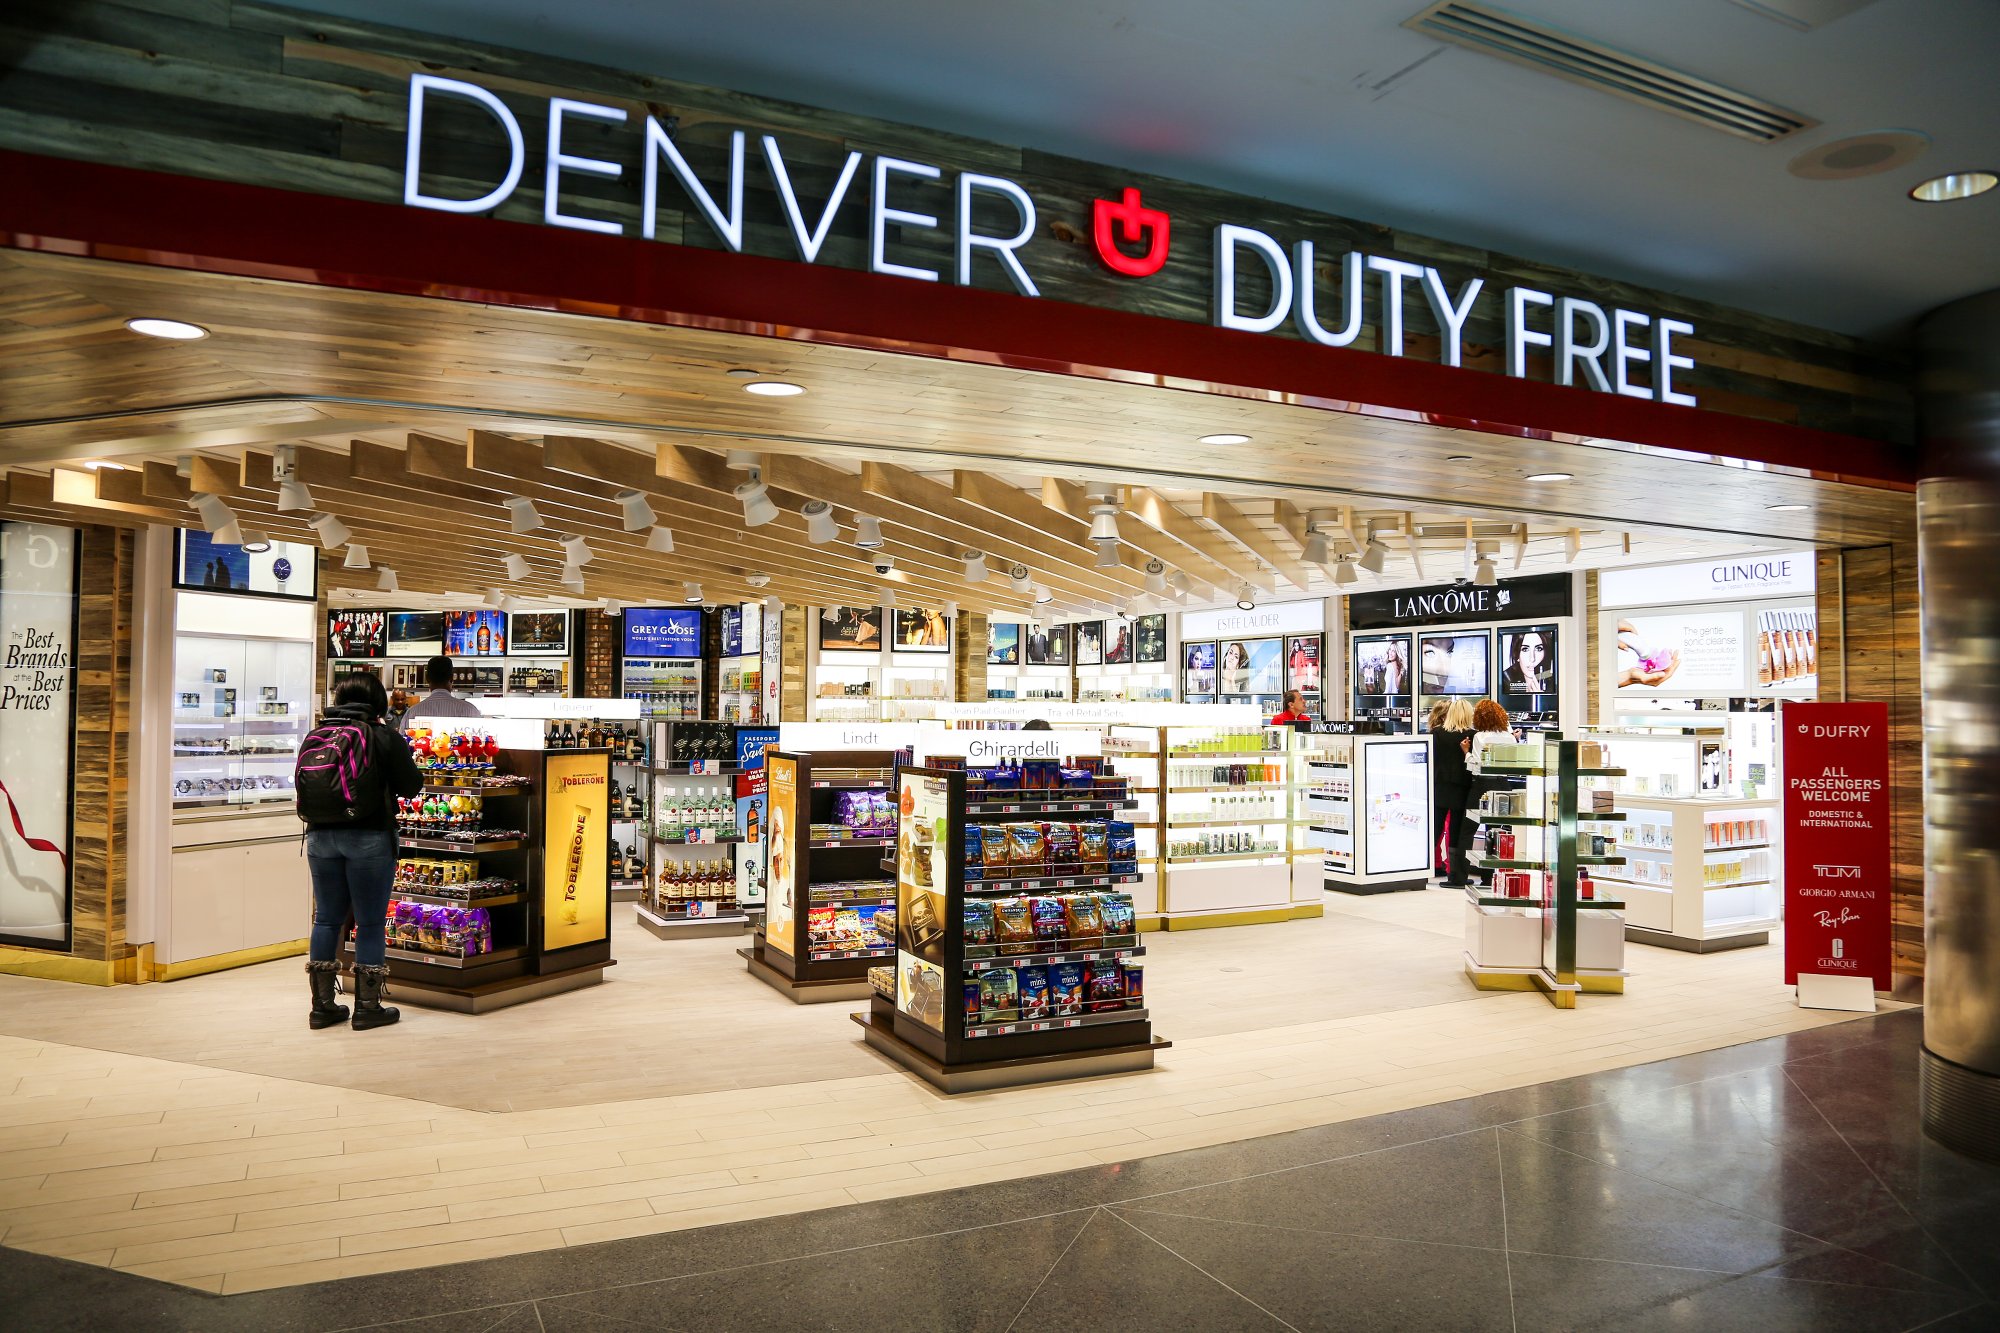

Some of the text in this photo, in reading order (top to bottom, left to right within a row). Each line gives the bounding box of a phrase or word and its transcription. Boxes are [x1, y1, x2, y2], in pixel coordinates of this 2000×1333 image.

[404, 73, 1040, 297] DENVER
[1214, 223, 1697, 407] DUTY FREE
[1711, 560, 1792, 583] CLINIQUE
[1394, 588, 1489, 618] LANCÔME
[1243, 613, 1279, 629] LAUDER
[631, 625, 695, 635] GREY GOOSE
[1699, 626, 1724, 638] gentle
[12, 627, 55, 649] The Best
[1683, 638, 1704, 647] sonic
[4, 643, 68, 669] Brands
[13, 670, 65, 692] at the Best
[0, 684, 52, 711] Prices
[553, 701, 593, 712] Liqueur
[950, 706, 1026, 716] Jean Paul Gaultier
[1047, 708, 1124, 718] Trael Retail Sets
[1310, 722, 1347, 733] LANCÔME
[1814, 725, 1871, 738] DUFRY
[843, 731, 879, 745] Lindt
[969, 740, 1059, 757] Ghirardelli
[748, 773, 764, 781] BRAN
[1822, 766, 1849, 778] ALL
[562, 776, 605, 787] TOBLERONE
[1790, 778, 1882, 790] PASSENGERS
[1801, 790, 1871, 802] WELCOME
[1808, 810, 1864, 819] DOMESTIC &
[1800, 819, 1873, 829] INTERNATIONAL
[565, 814, 587, 902] TOBLERONE
[1813, 864, 1861, 878] TUMI
[1799, 888, 1875, 899] GIORGIO ARMANI
[1813, 906, 1861, 929] Ray-Ban
[1817, 958, 1858, 969] CLINIQUE
[1029, 977, 1047, 987] minis
[1061, 975, 1079, 984] minis
